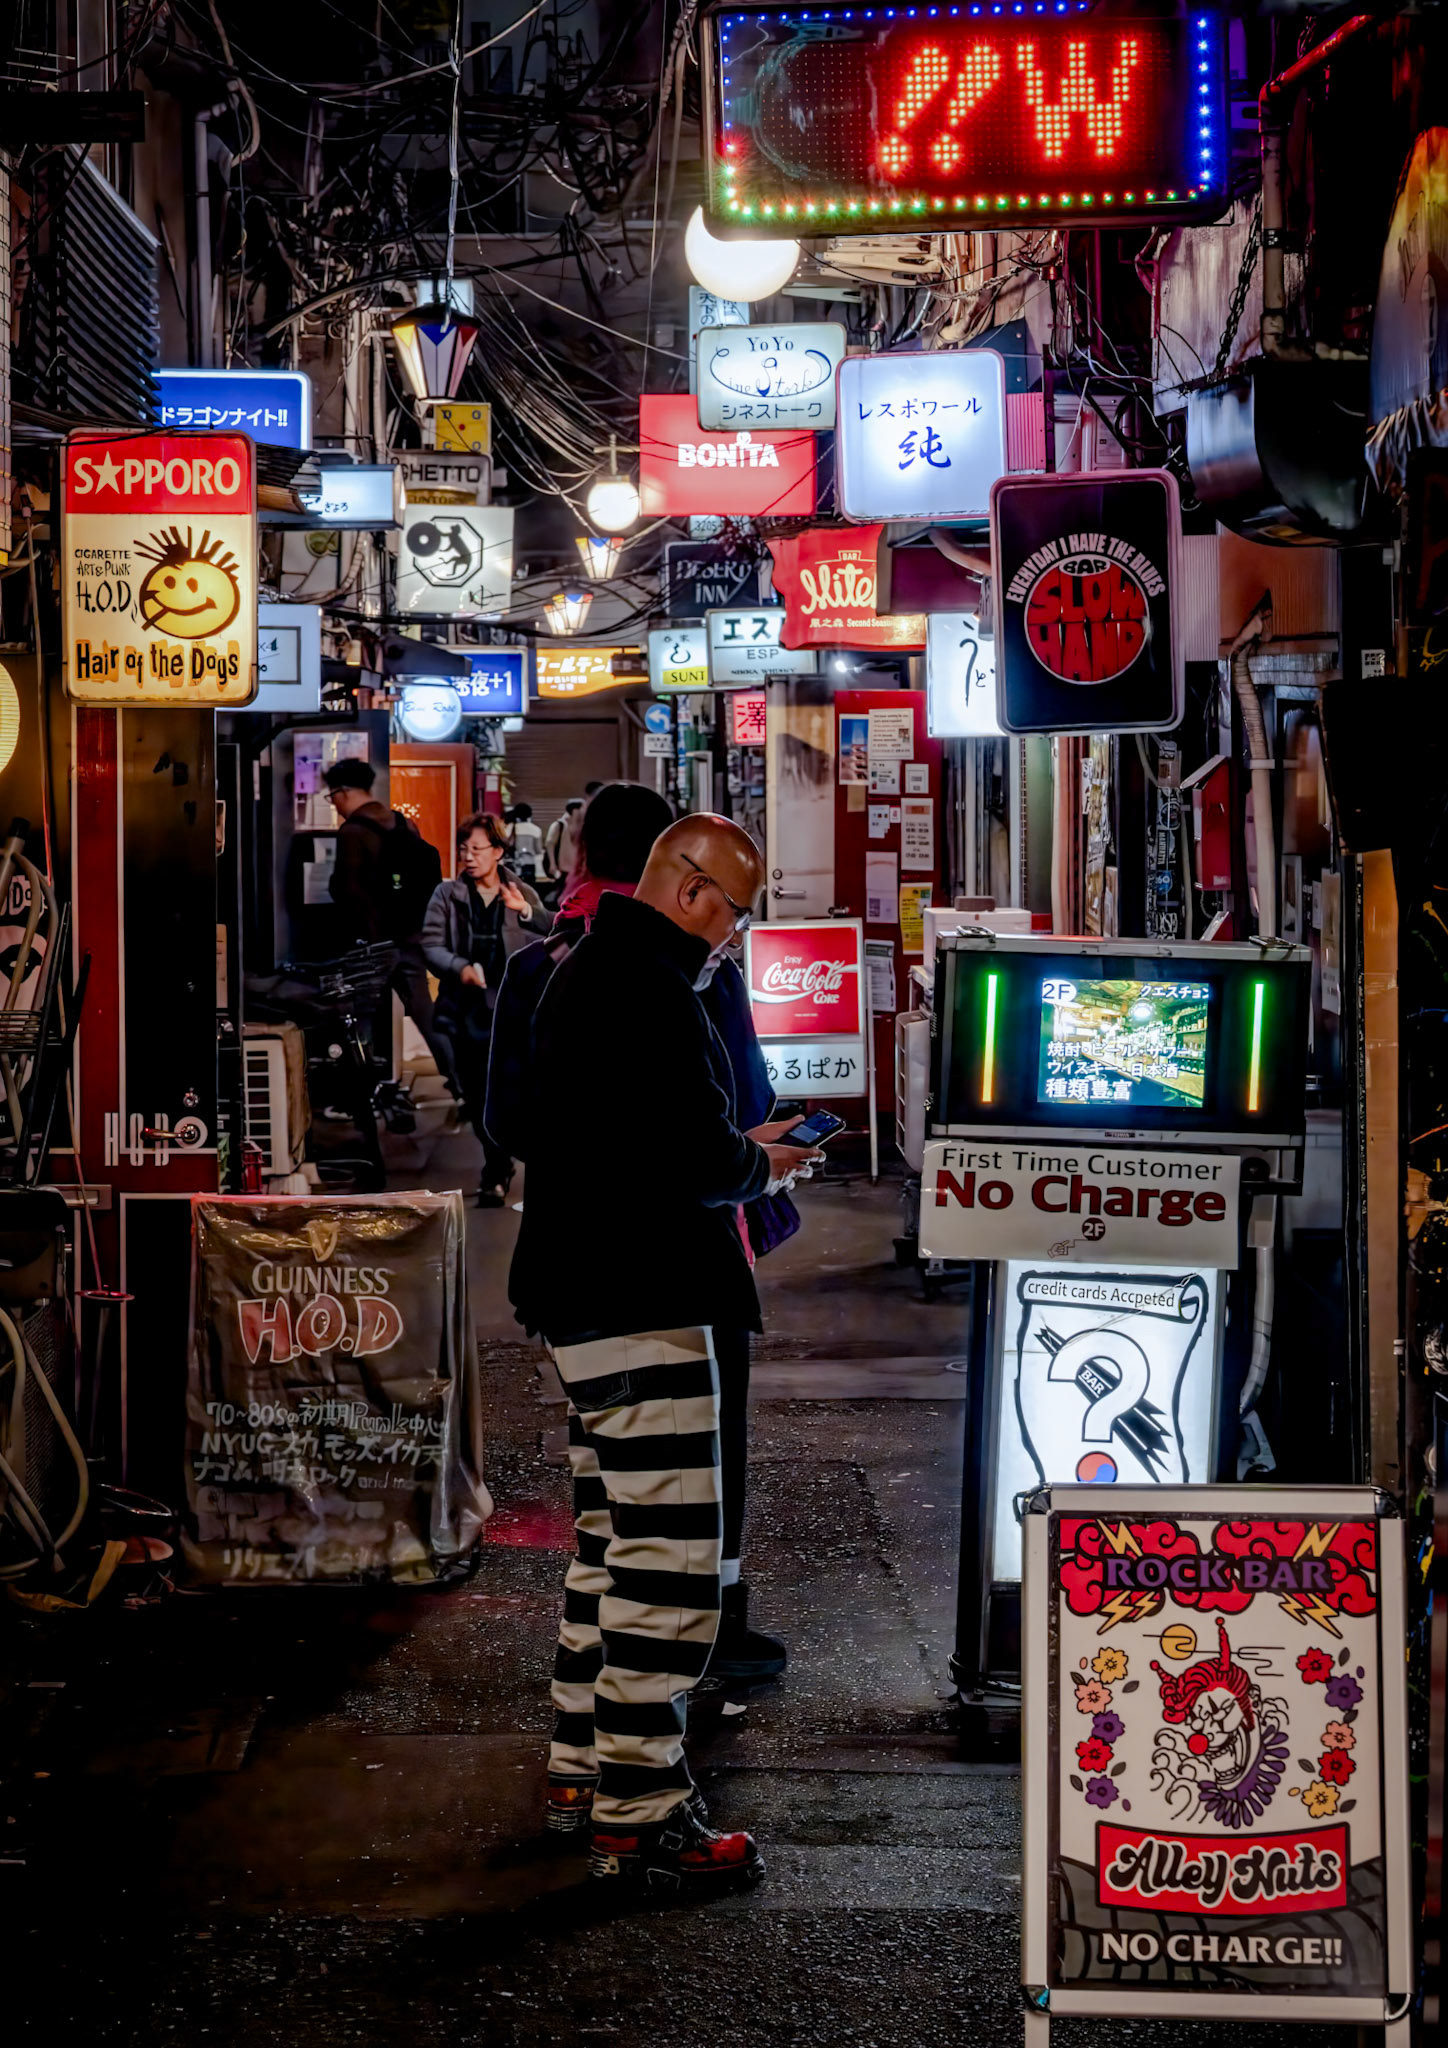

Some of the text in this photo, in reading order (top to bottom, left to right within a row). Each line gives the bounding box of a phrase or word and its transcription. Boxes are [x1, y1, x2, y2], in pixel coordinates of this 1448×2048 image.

[722, 403, 822, 419] シネストーク
[858, 398, 983, 420] レスポワール
[678, 434, 779, 467] BONITA
[898, 426, 952, 470] 純
[401, 463, 480, 483] GHETTO
[75, 549, 131, 559] CIGARETTE
[842, 553, 858, 561] BAR
[1005, 541, 1060, 604] EVERYDAY
[1068, 533, 1107, 553] HAVE
[1109, 537, 1136, 563] THE
[1128, 552, 1166, 598] BLUES
[1063, 559, 1107, 575] BAR
[1027, 566, 1146, 624] SLOW
[847, 619, 871, 628] Second
[77, 643, 119, 679] Hair
[126, 652, 143, 684] of
[151, 644, 184, 680] the
[191, 647, 239, 686] Dogs
[1027, 620, 1146, 681] HAND
[1044, 983, 1071, 1000] 2F
[1047, 1061, 1180, 1079] ウイスキー・日本酒
[1046, 1078, 1133, 1101] 種類豊富
[942, 1148, 1222, 1181] First Time Customer
[935, 1169, 1226, 1227] No Charge
[1083, 1222, 1105, 1237] 2F
[252, 1261, 390, 1295] GUINNESS
[1028, 1281, 1175, 1309] credit cards Accpeted
[1080, 1367, 1105, 1396] BAR
[1106, 1558, 1331, 1590] ROCK BAR
[1106, 1837, 1343, 1908] Alley Nuts
[1102, 1933, 1343, 1966] NO CHARGE!!
